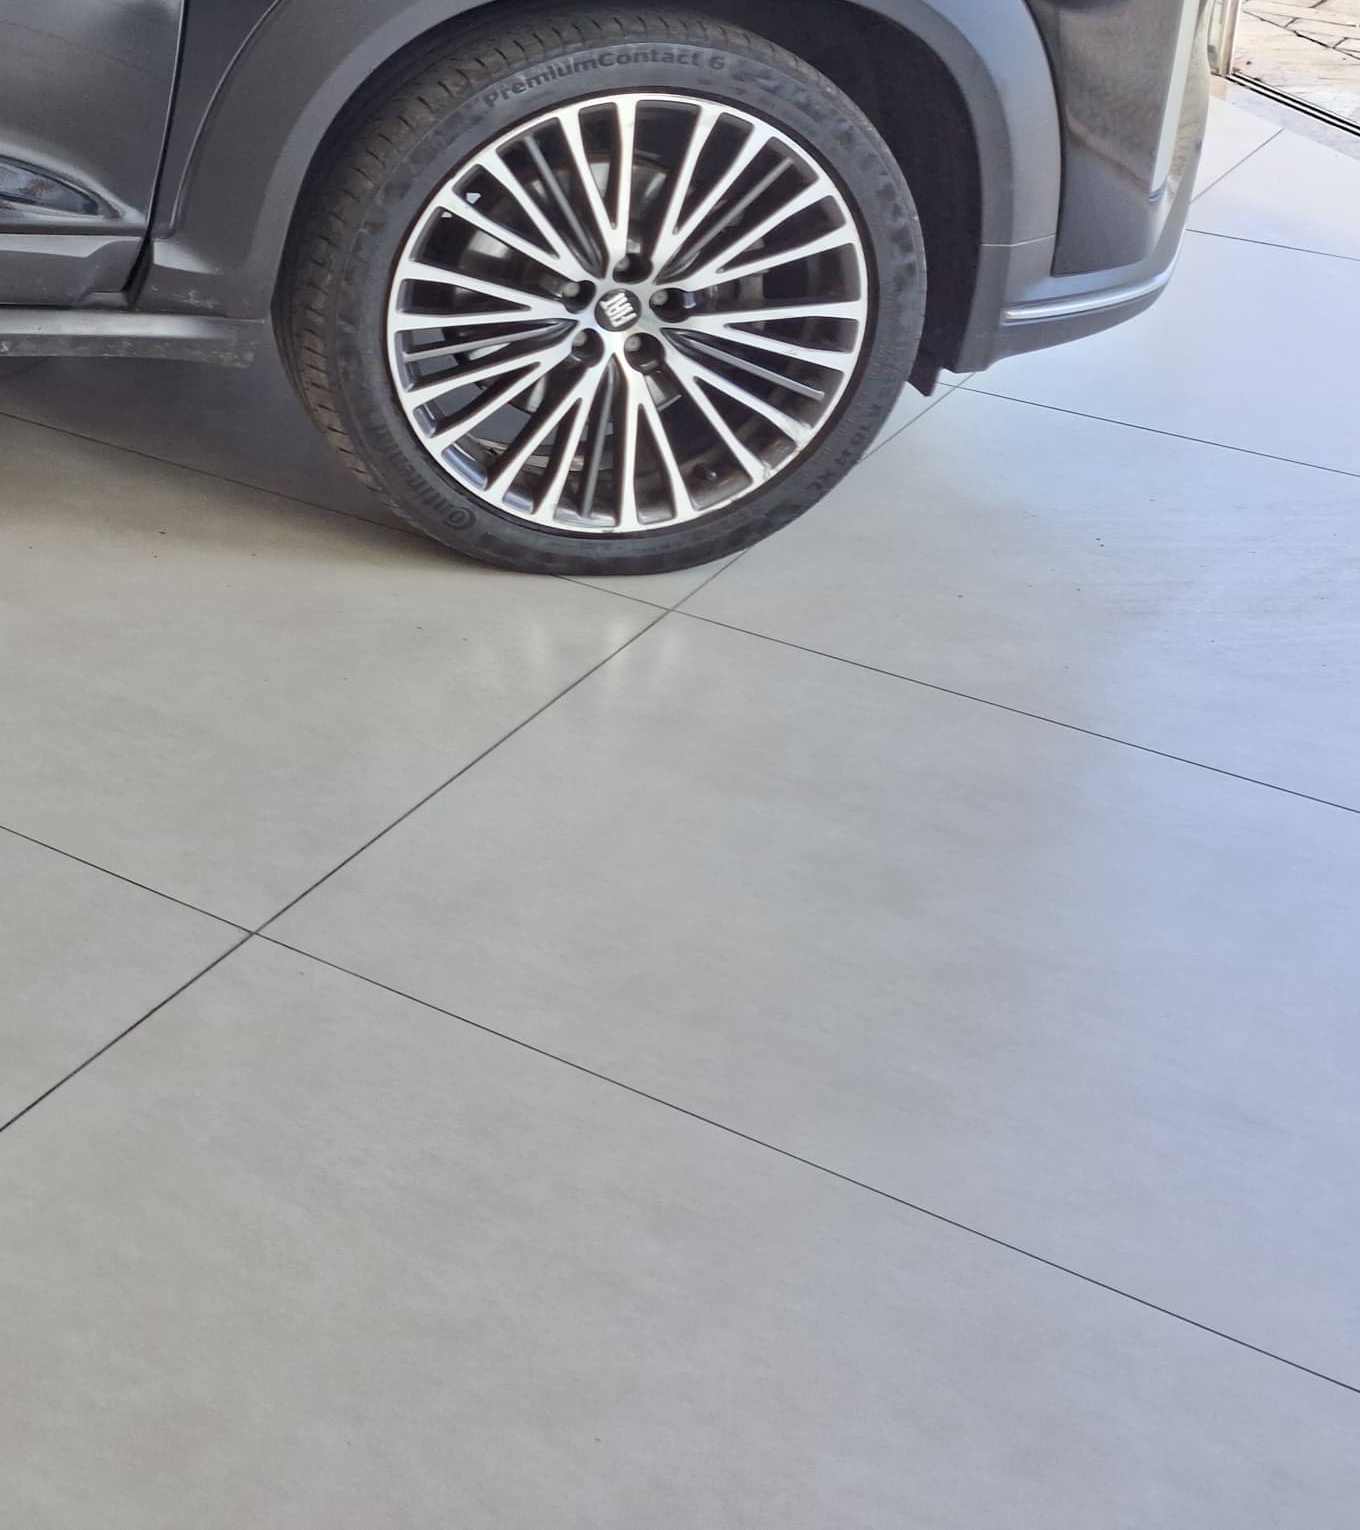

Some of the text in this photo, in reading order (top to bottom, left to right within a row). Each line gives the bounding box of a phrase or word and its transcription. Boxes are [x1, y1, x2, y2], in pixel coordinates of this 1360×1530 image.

[484, 48, 726, 108] PremiumContact 6
[599, 292, 637, 328] FIAT
